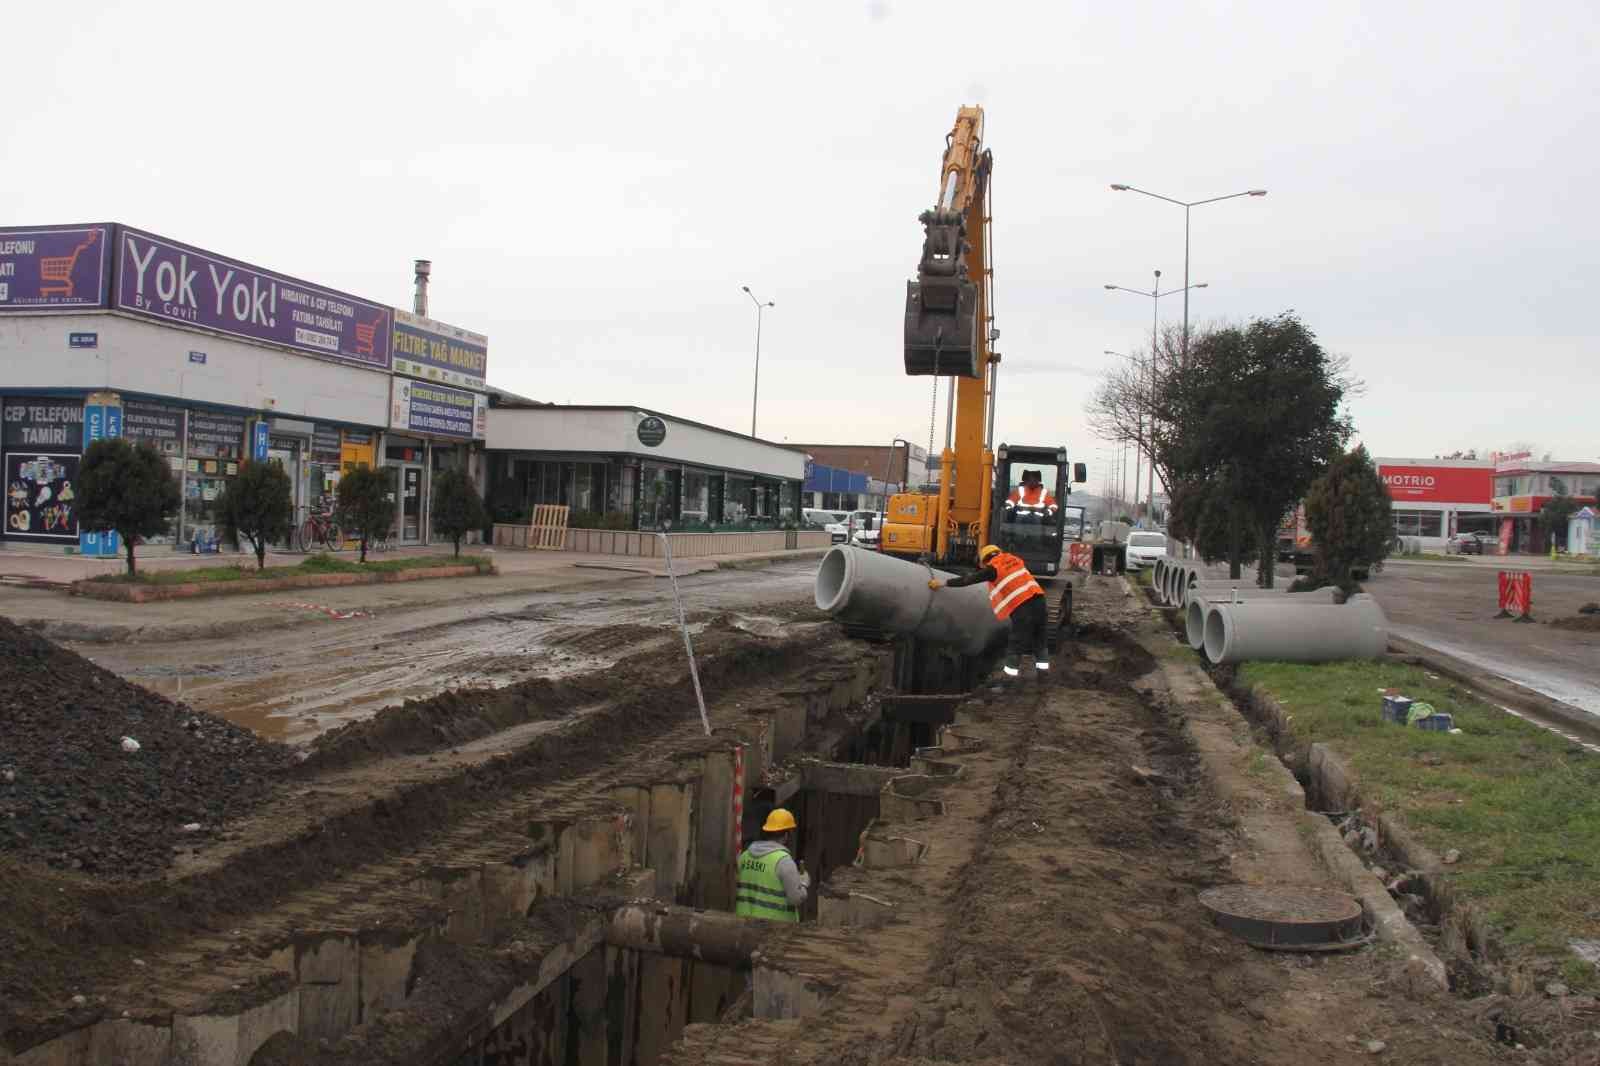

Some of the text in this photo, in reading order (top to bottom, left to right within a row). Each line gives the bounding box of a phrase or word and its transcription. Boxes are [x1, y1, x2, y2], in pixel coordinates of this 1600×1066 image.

[127, 238, 275, 328] Yok Yok!
[136, 294, 151, 310] By
[449, 345, 486, 372] MARKET
[4, 406, 25, 421] CEP
[22, 425, 67, 444] TAMİRİ
[1382, 475, 1435, 486] MOTRIO
